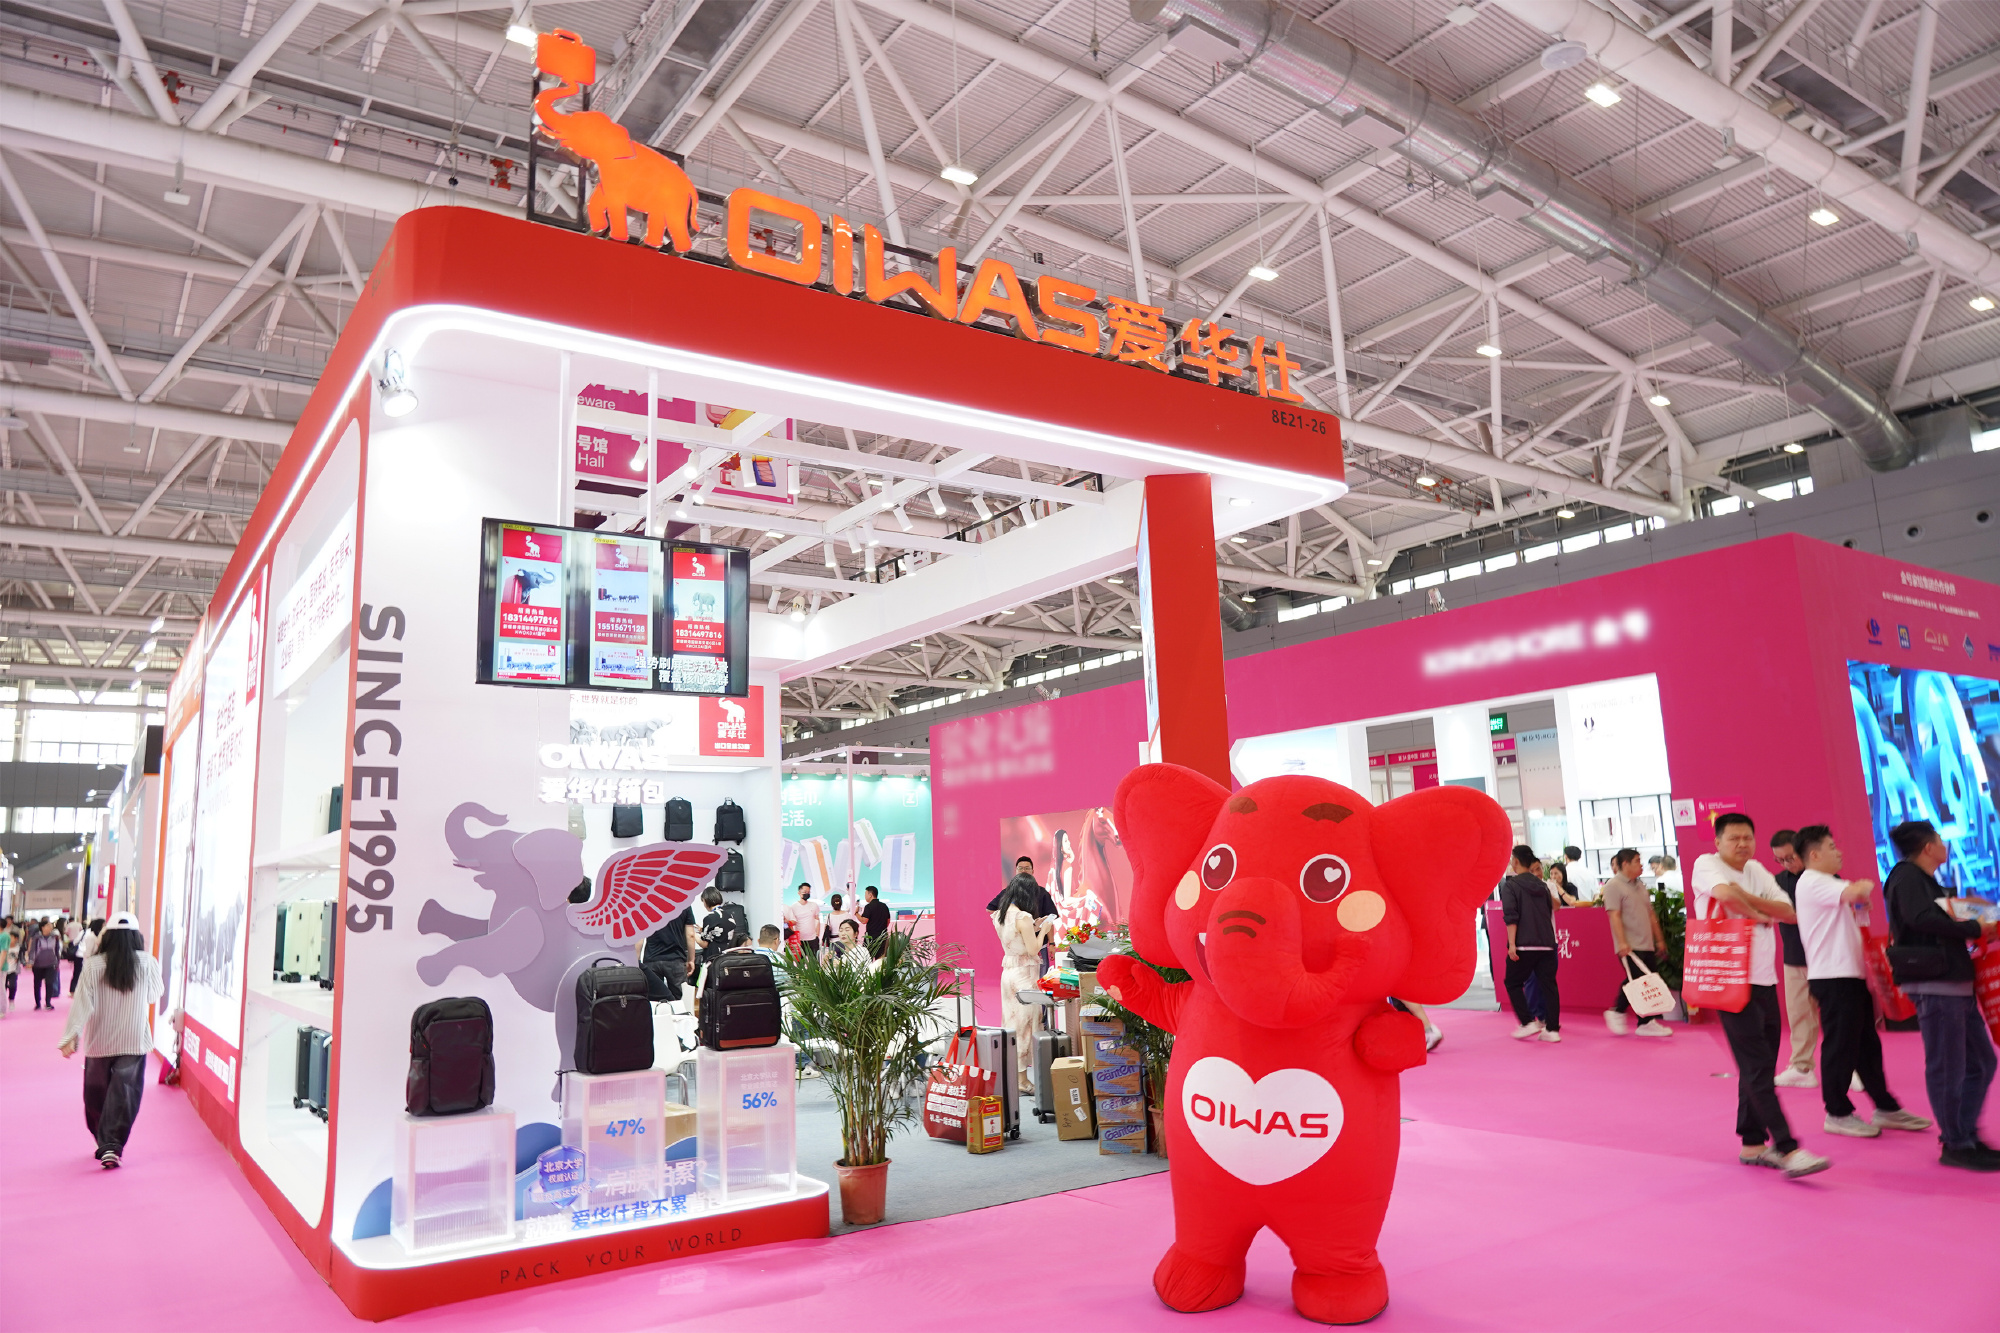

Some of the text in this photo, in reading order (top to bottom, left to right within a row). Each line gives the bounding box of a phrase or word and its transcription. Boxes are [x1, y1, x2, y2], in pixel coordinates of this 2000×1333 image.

[725, 187, 1304, 403] OIWAS 爱华仕
[1271, 409, 1328, 436] 8E21-26
[578, 452, 605, 468] Hall
[502, 613, 559, 626] 18314497816
[675, 629, 723, 639] 18314497816
[717, 722, 747, 730] OIWAS
[539, 743, 668, 771] OIWAS
[538, 776, 665, 805] 爱华仕箱包
[742, 1091, 778, 1110] 56%
[1191, 1093, 1329, 1139] OIWAS
[605, 1117, 646, 1138] 47%
[543, 1158, 583, 1174] 北京大学
[547, 1171, 580, 1184] 权威认证
[500, 1227, 742, 1284] PACK YOUR WORLD
